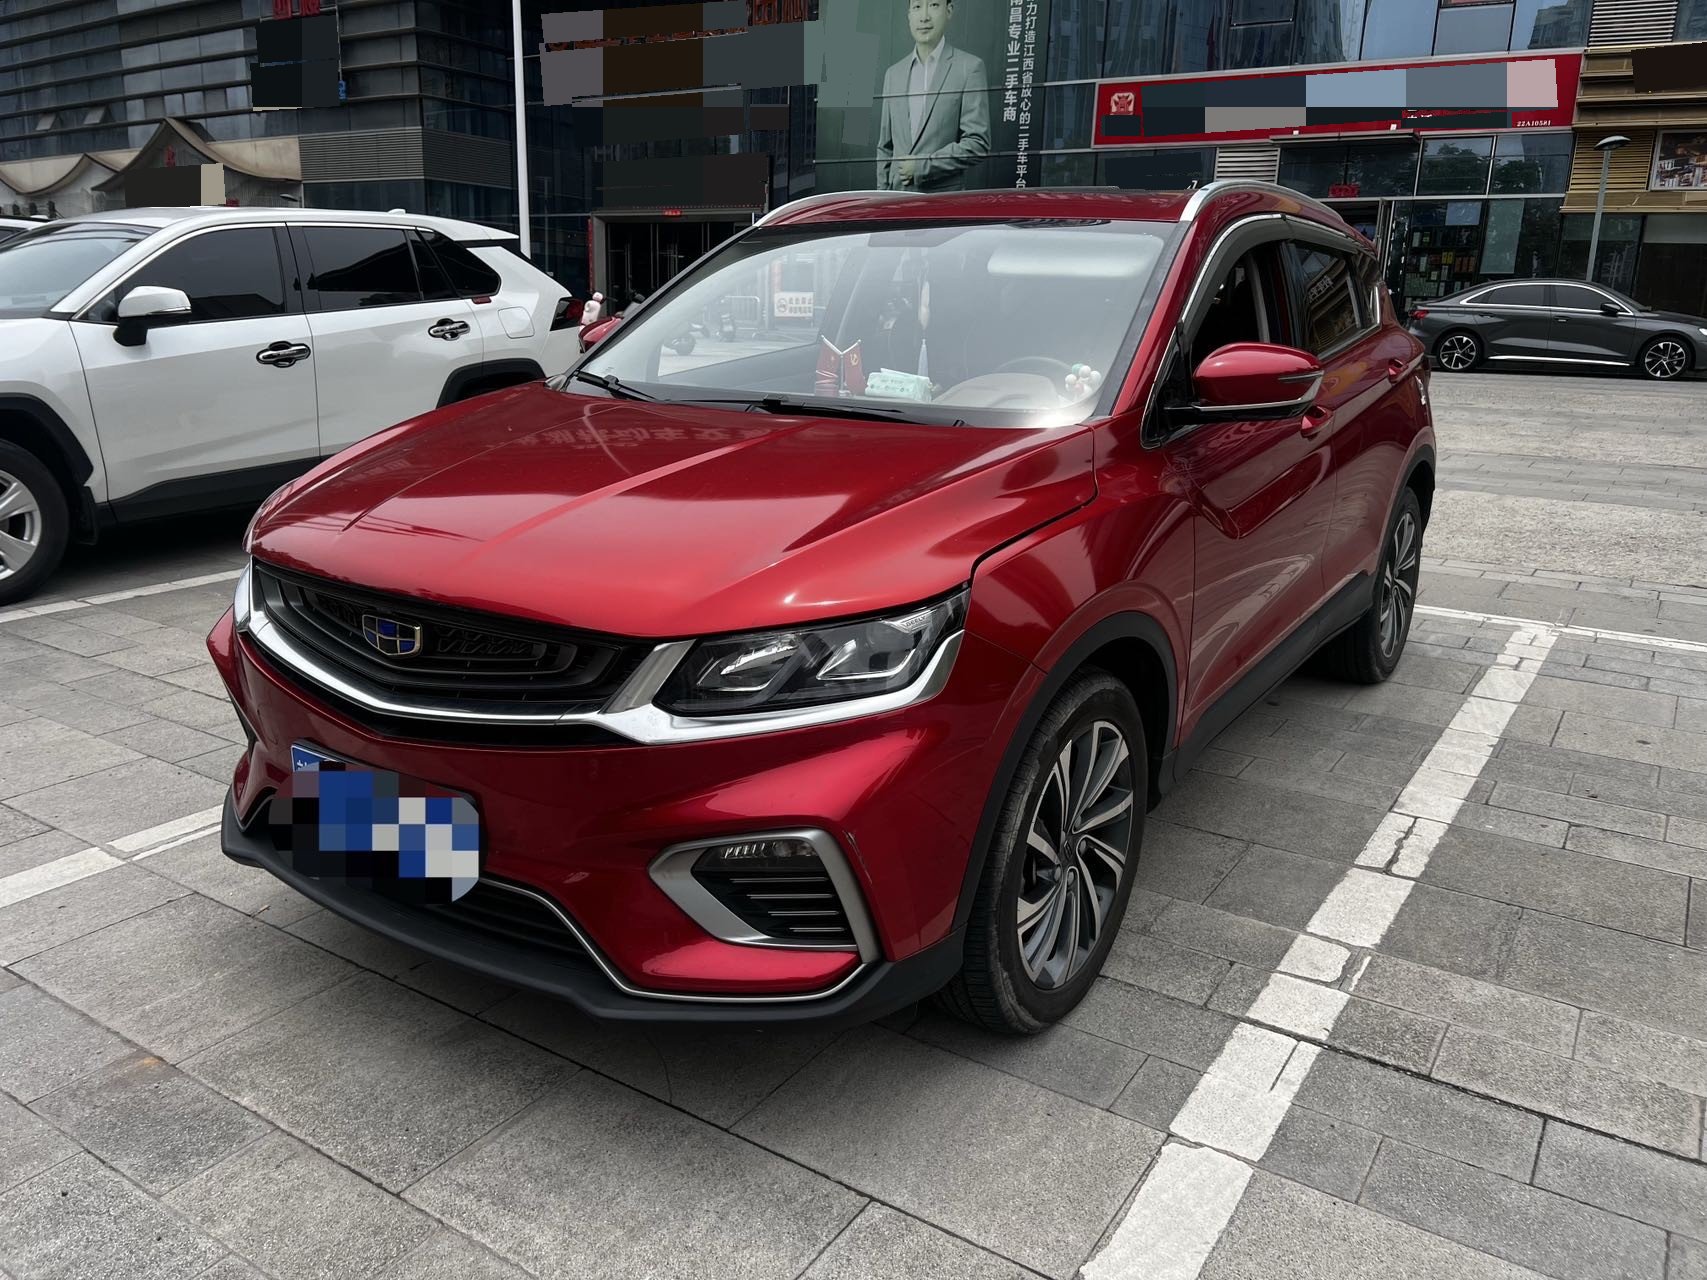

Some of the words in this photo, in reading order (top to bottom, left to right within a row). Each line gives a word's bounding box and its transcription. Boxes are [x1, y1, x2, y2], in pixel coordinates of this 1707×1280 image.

[1016, 0, 1038, 189] 力打造江西省放心的二手车平台
